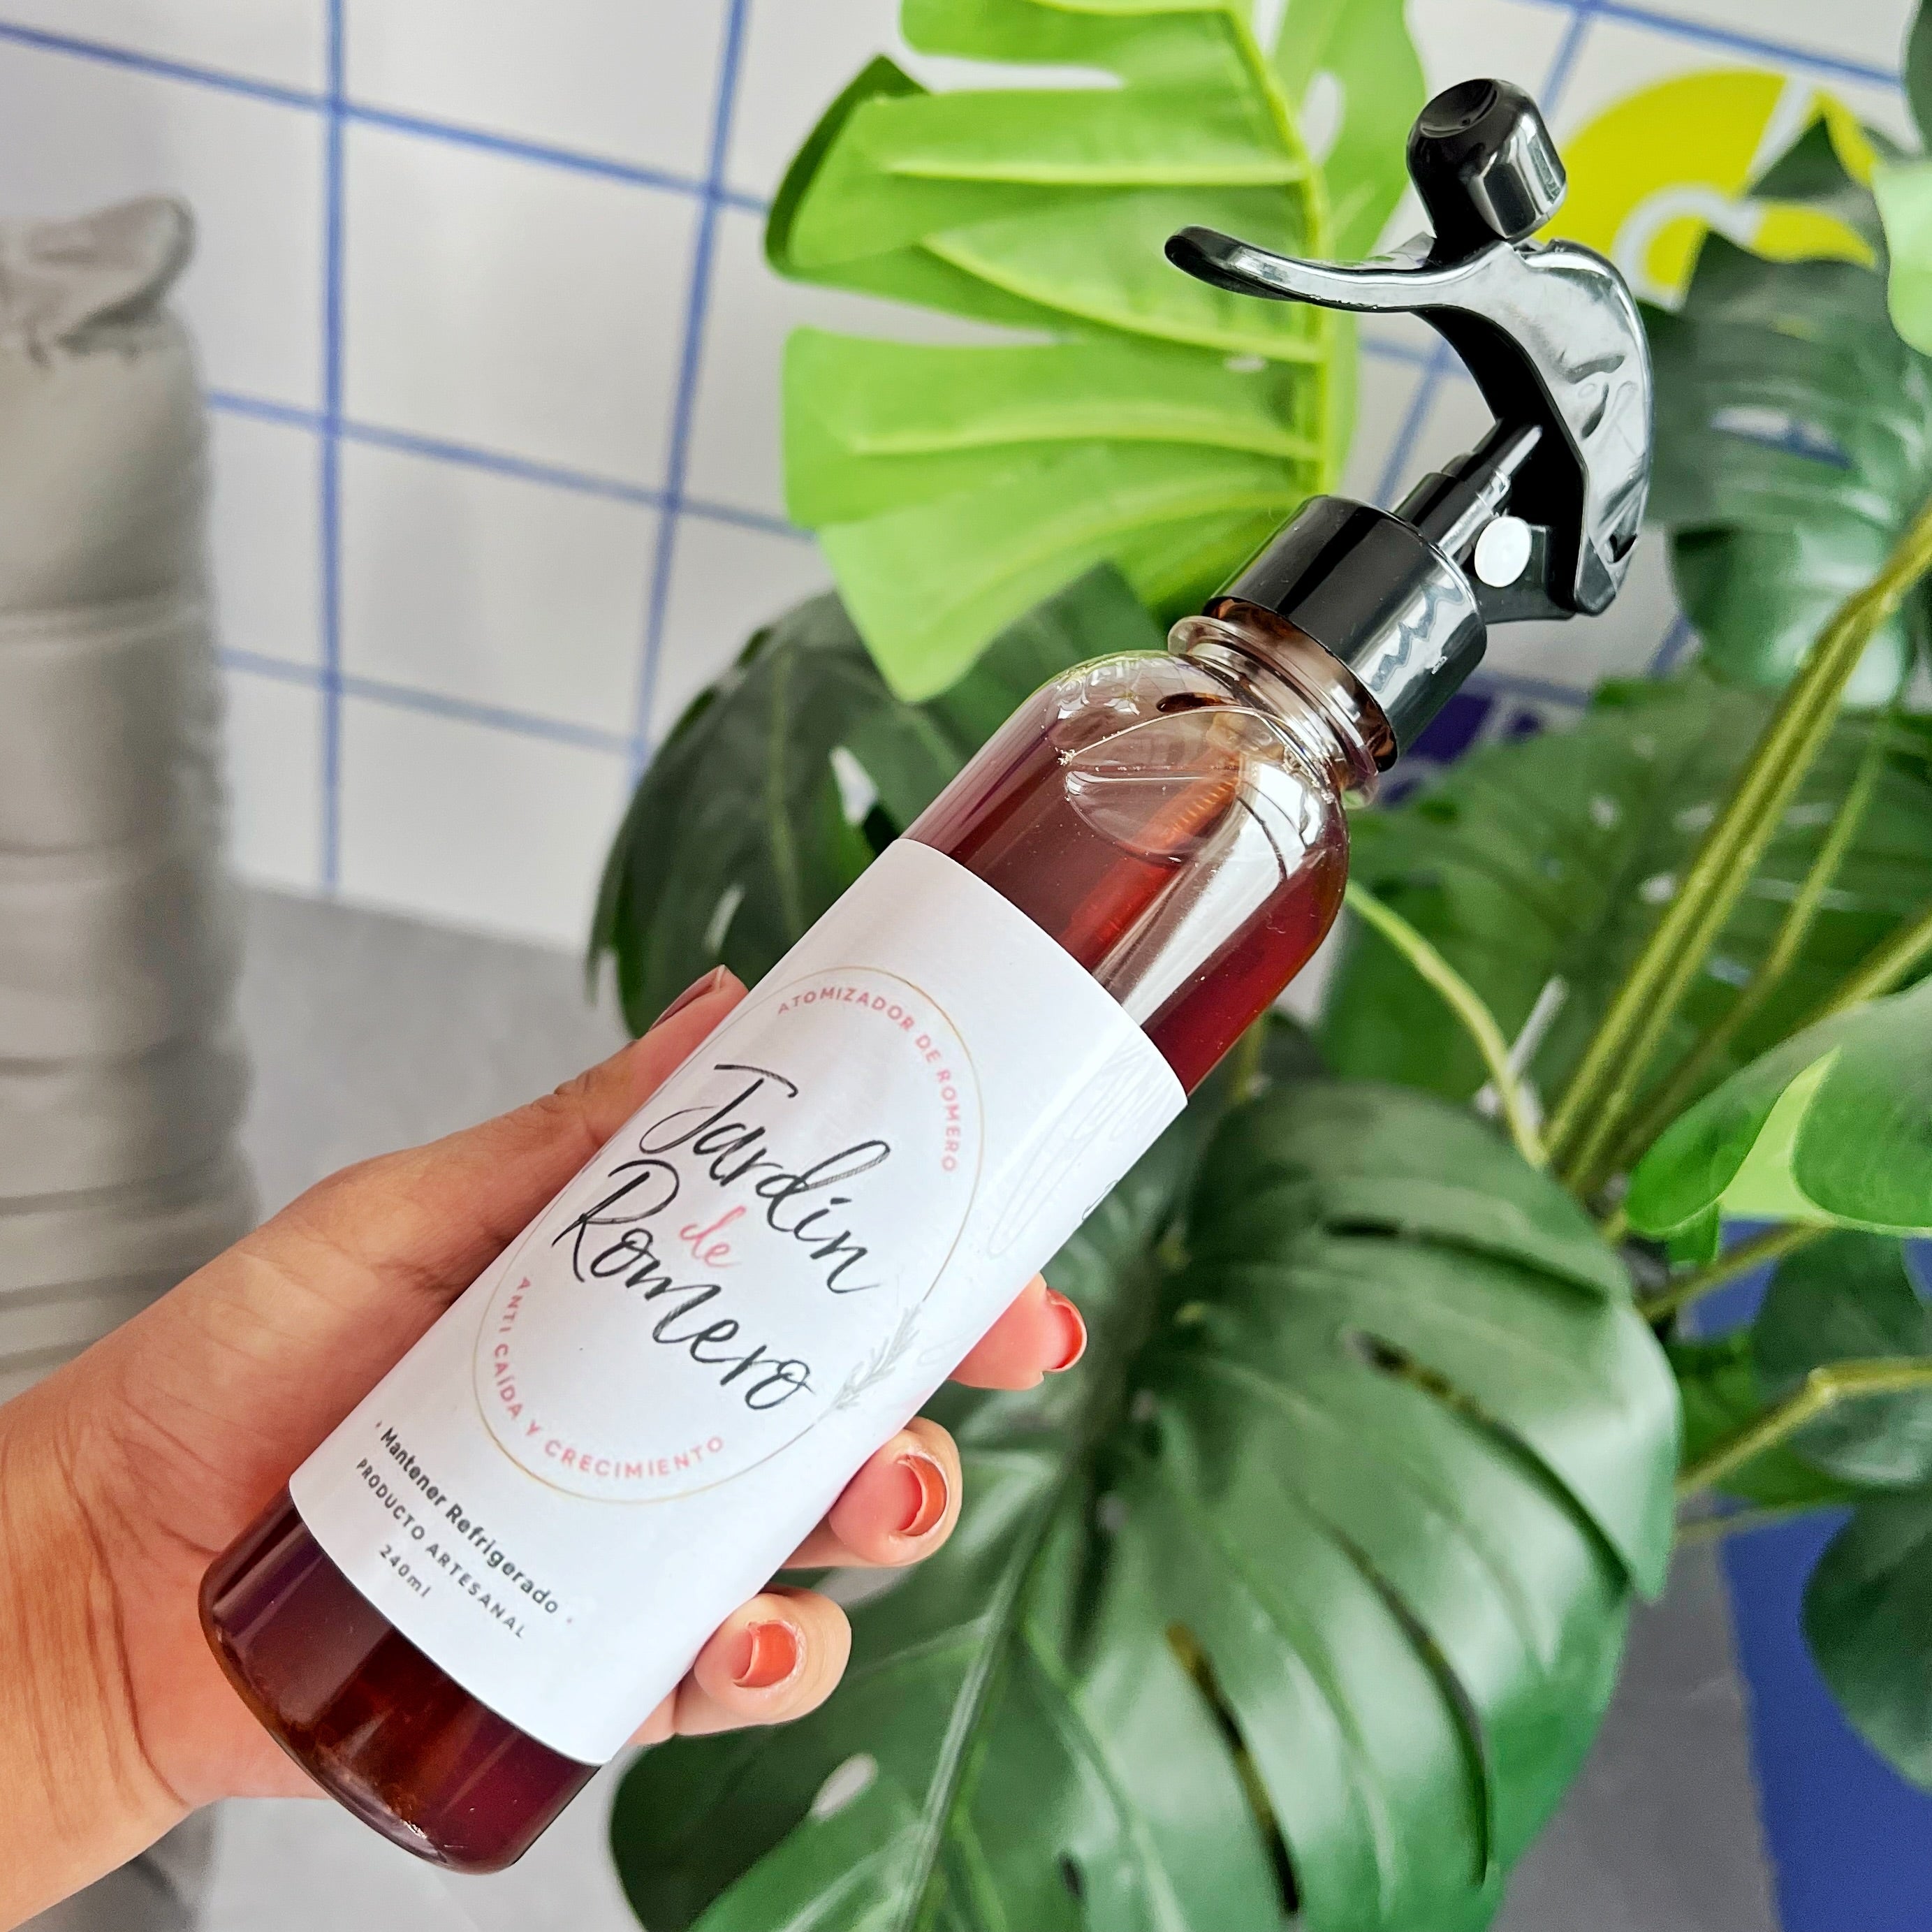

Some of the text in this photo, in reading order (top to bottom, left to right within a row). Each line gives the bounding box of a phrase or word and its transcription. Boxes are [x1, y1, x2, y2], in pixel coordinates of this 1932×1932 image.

[777, 986, 961, 1172] ATOMIZADOR DE ROMERO
[551, 1158, 816, 1410] Romero
[678, 1206, 747, 1268] de
[498, 1276, 531, 1333] ANTI
[525, 1419, 542, 1437] Y
[544, 1436, 724, 1479] CRECIMIENTO
[356, 1457, 525, 1639] PRODUCTO ARTESANAL
[379, 1544, 432, 1598] 240ml
[380, 1426, 559, 1614] Mantener Refrigerado
